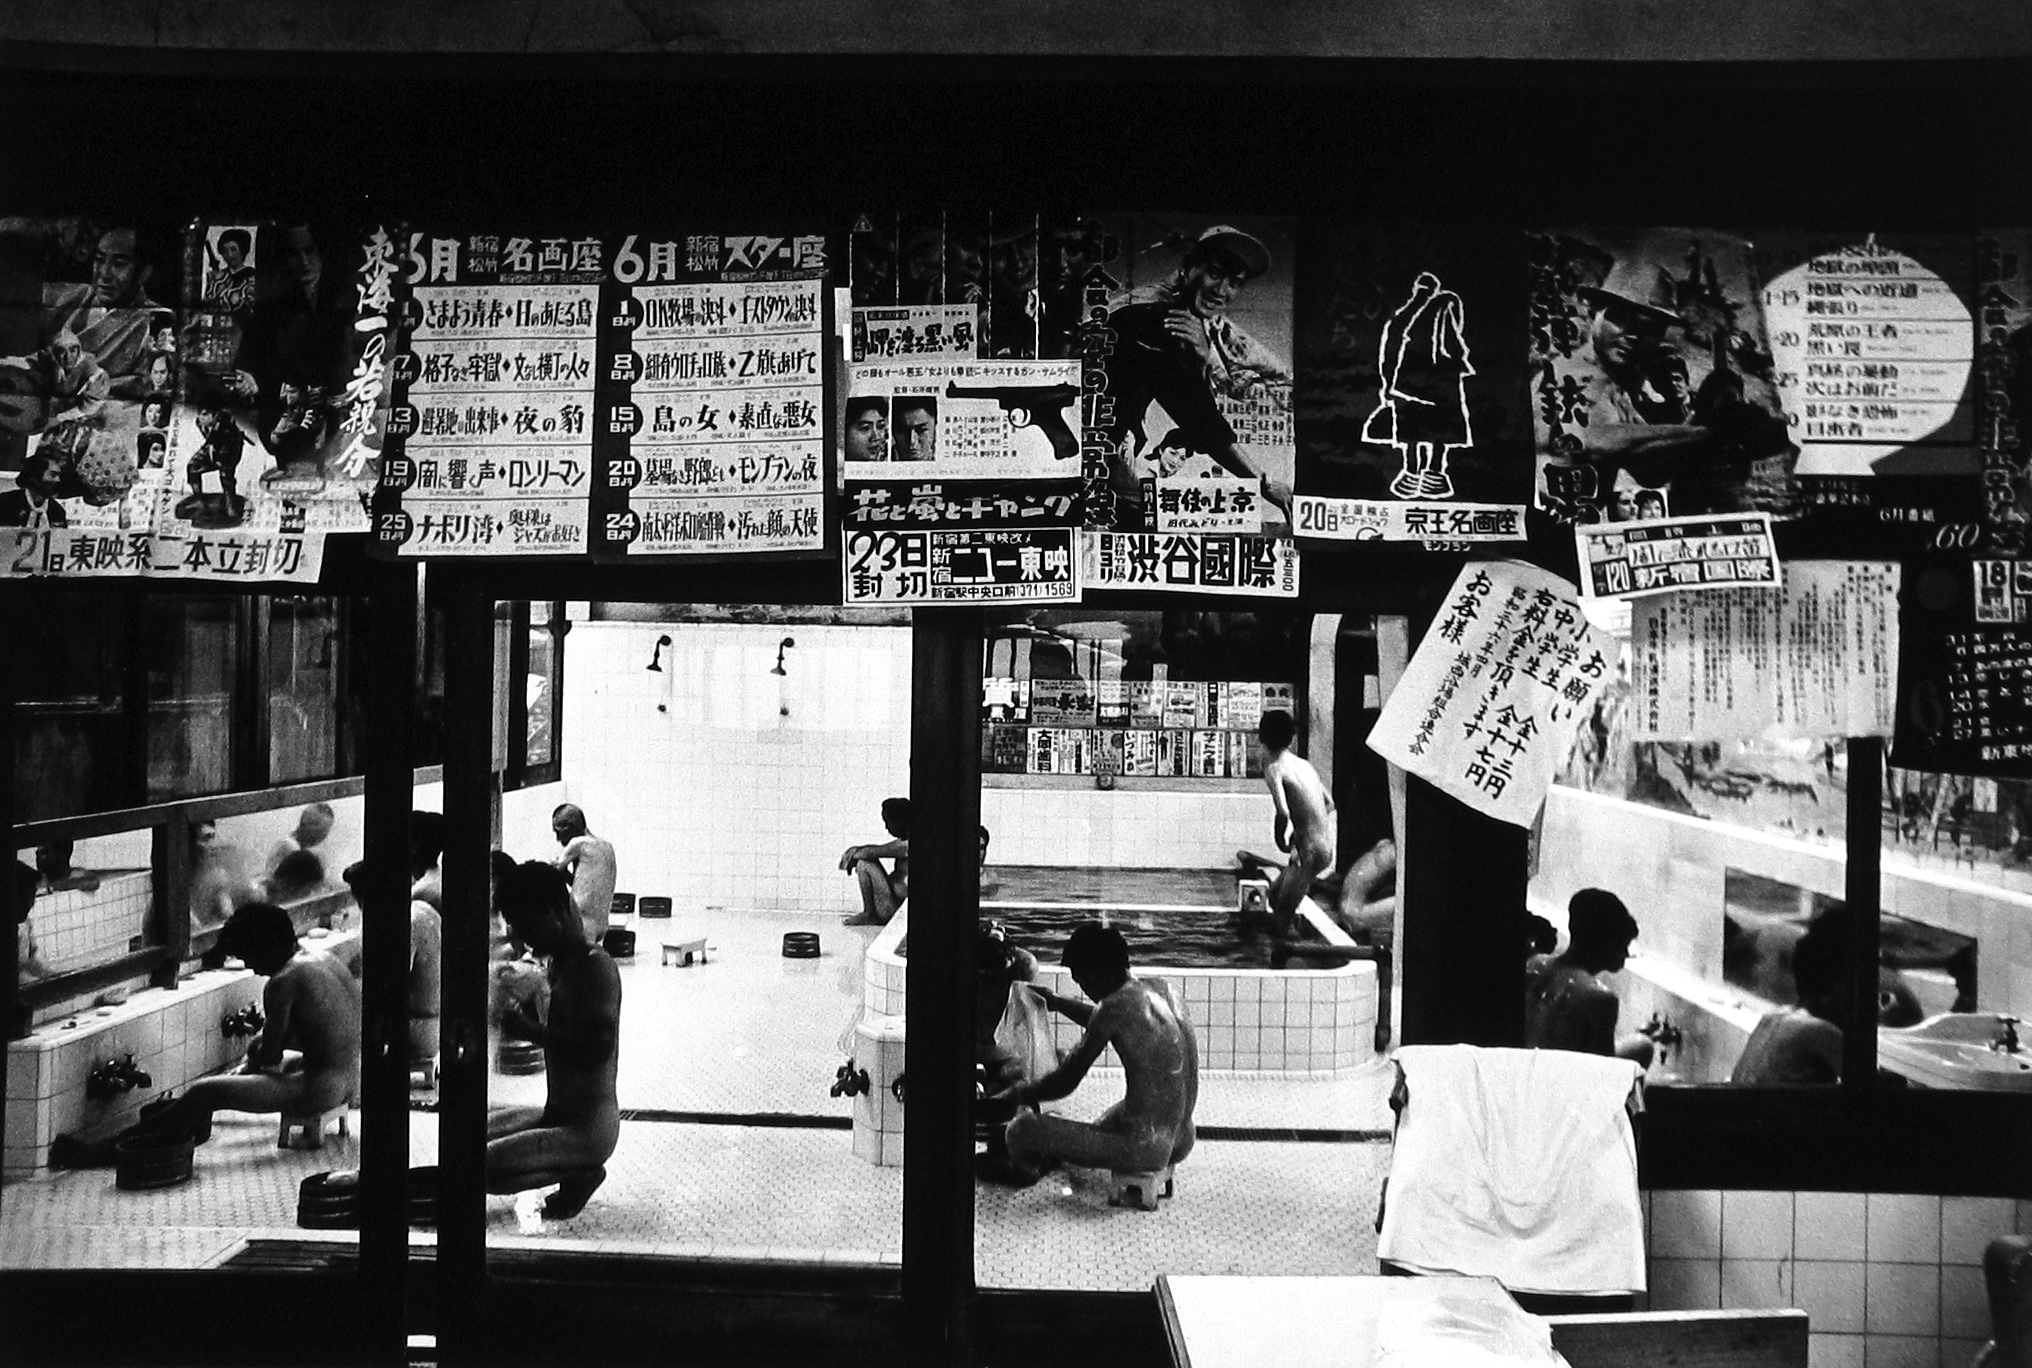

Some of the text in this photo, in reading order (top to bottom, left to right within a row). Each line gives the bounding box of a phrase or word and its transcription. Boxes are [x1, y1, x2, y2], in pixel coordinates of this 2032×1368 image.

[406, 232, 461, 284] 6月
[468, 235, 499, 253] 新宿
[501, 236, 602, 272] 名画座
[613, 234, 678, 284] 6月
[686, 235, 720, 252] 新宿
[724, 235, 829, 271] スター座
[467, 257, 498, 273] 松竹
[686, 255, 719, 272] 松竹
[425, 298, 594, 329] さまよう青春 日のあたる島
[620, 300, 630, 316] 1
[646, 297, 728, 328] OK牧場の決斗
[332, 225, 399, 478] 東海一の若親分
[422, 352, 591, 384] 格子なき牢獄 文なし横丁の人々
[614, 354, 633, 370] 8
[387, 407, 412, 423] 13
[421, 404, 585, 436] 避暑地の出来事 夜の豹
[610, 406, 636, 422] 15
[652, 399, 818, 434] 島の女 素直な悪女
[385, 461, 409, 477] 19
[417, 458, 586, 490] 闇に響く声 ロンリーマン
[608, 460, 637, 476] 20
[642, 453, 819, 487] 墓場なき野郎ども モンブランの夜
[849, 484, 1080, 523] 花と嵐とギャング
[1299, 501, 1339, 532] 20日
[381, 513, 407, 531] 25
[416, 508, 552, 545] ナポリ湾 奥様は
[606, 513, 636, 529] 24
[737, 507, 819, 540] 汚れた顔の天使
[1405, 506, 1520, 536] 京王名画座
[11, 532, 303, 575] 21日東映系二本立封切
[850, 529, 928, 574] 23日
[932, 547, 953, 585] 新宿
[1100, 534, 1114, 584] 日ヨリ
[1127, 534, 1278, 589] 渋谷國際
[853, 572, 928, 599] 封切
[1604, 560, 1632, 593] 120
[1438, 569, 1493, 647] お客様
[1463, 586, 1556, 741] 右料金を頂きます
[1550, 650, 1606, 722] お願い
[1482, 620, 1592, 800] 小学生 金十三円
[1464, 703, 1519, 787] 金十七円
